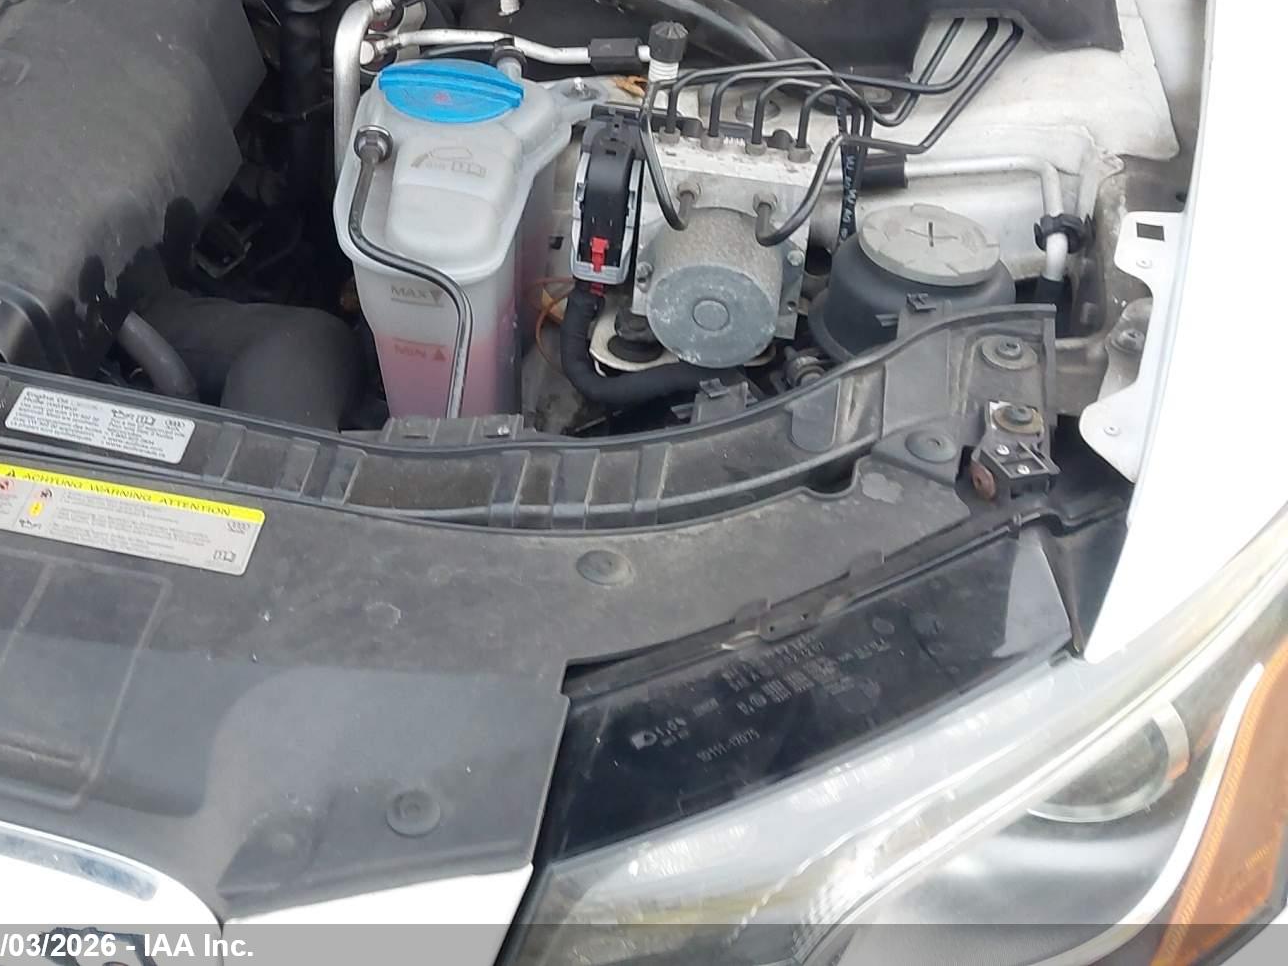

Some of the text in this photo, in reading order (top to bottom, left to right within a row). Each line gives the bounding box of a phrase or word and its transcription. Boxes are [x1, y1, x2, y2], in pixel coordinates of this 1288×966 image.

[391, 285, 427, 300] MAX
[24, 472, 231, 517] ACHTUNG WARNING ATTENTION
